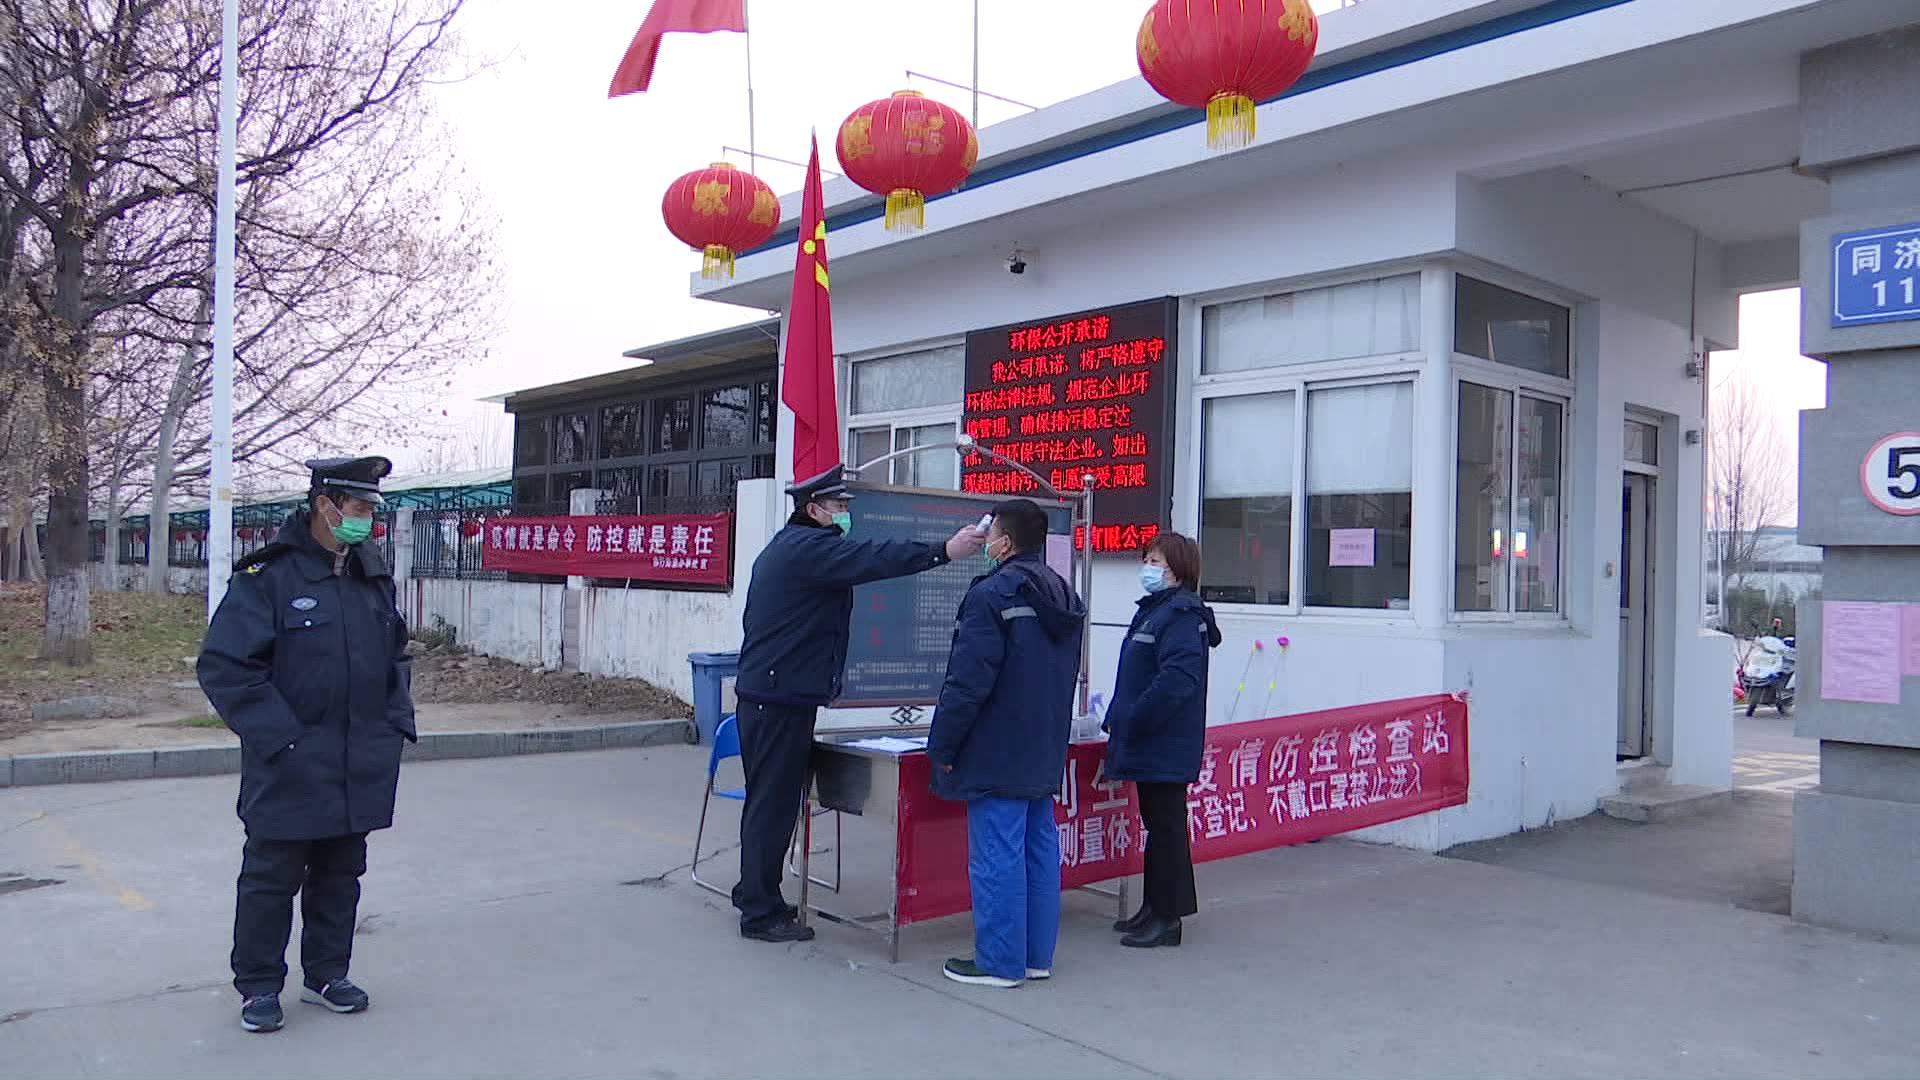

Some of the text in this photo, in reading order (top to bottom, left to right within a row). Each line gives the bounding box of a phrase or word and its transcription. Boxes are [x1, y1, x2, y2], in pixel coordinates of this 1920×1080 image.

[1852, 237, 1920, 276] 同济
[1872, 277, 1914, 306] 11
[1010, 315, 1110, 351] 环保公开承诺
[491, 524, 715, 555] 疫情就是命令 防控就是责任
